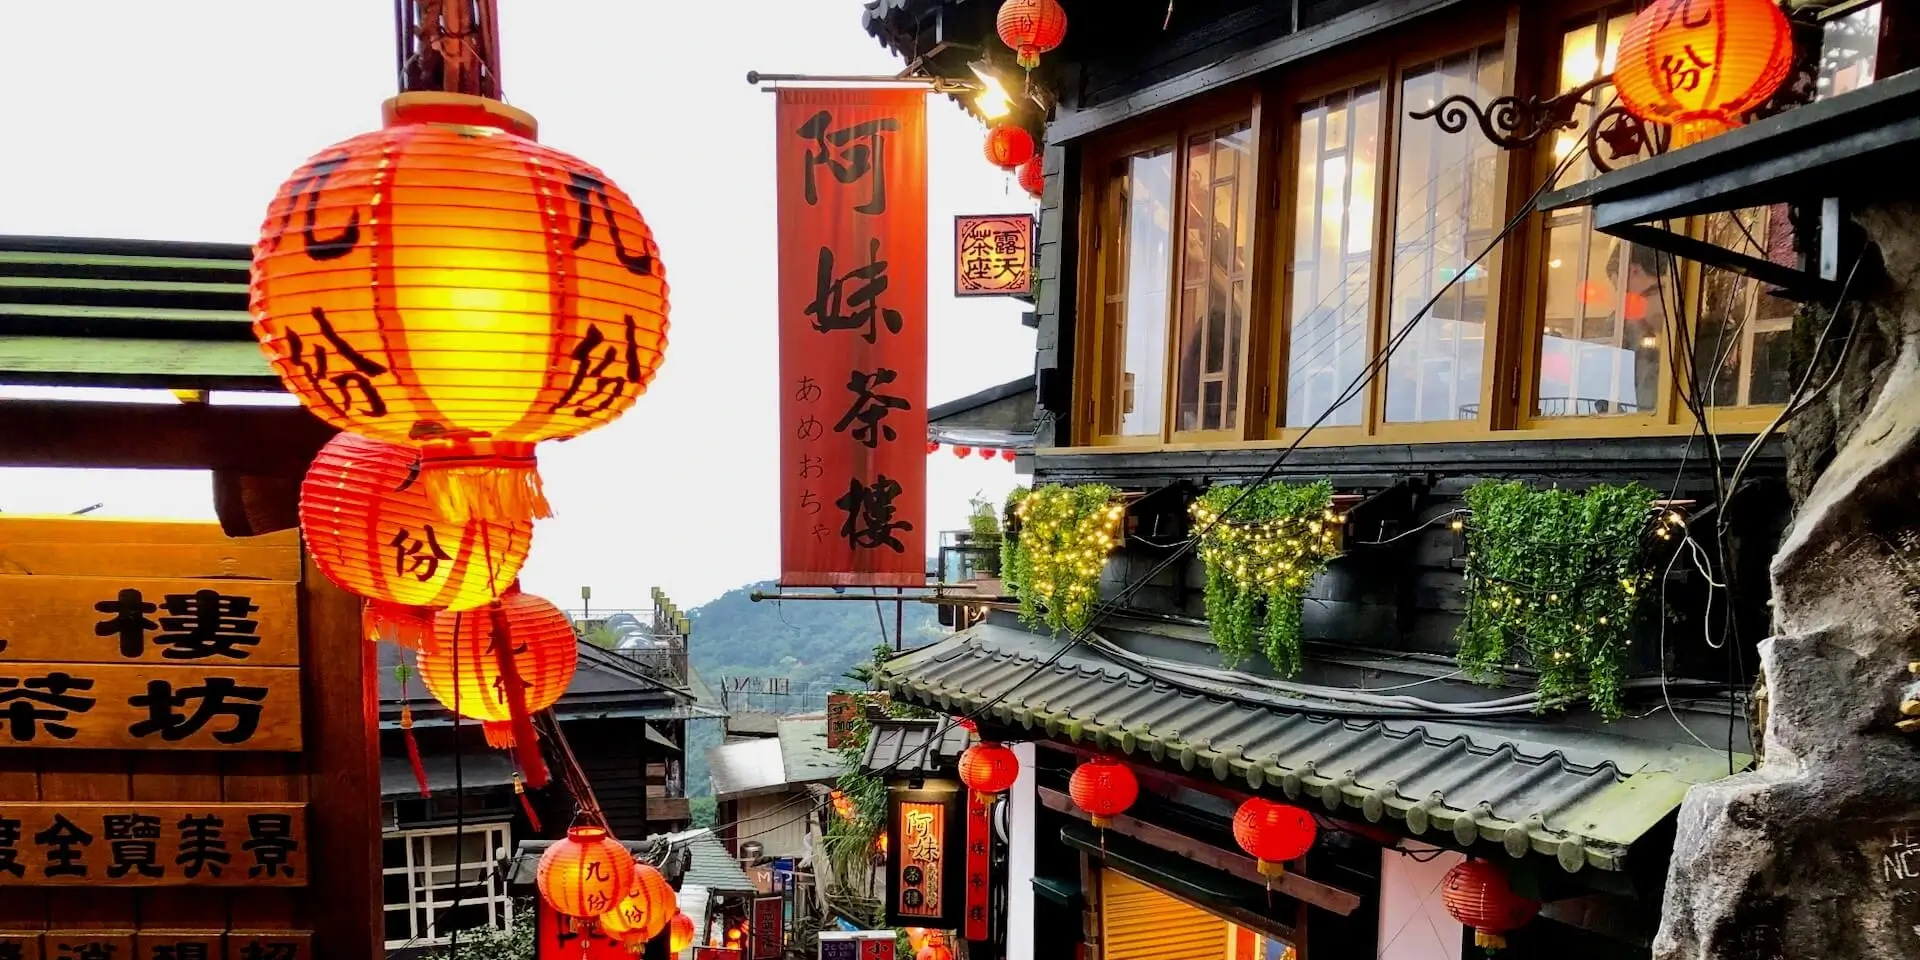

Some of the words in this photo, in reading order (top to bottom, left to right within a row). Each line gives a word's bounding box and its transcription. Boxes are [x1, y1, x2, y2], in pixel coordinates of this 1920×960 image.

[272, 153, 387, 418] 九份
[549, 171, 653, 418] 九份
[796, 110, 914, 554] 阿妹茶樓
[796, 376, 831, 544] あめおちゃ
[0, 672, 269, 744] 茶坊
[585, 861, 612, 912] 九份
